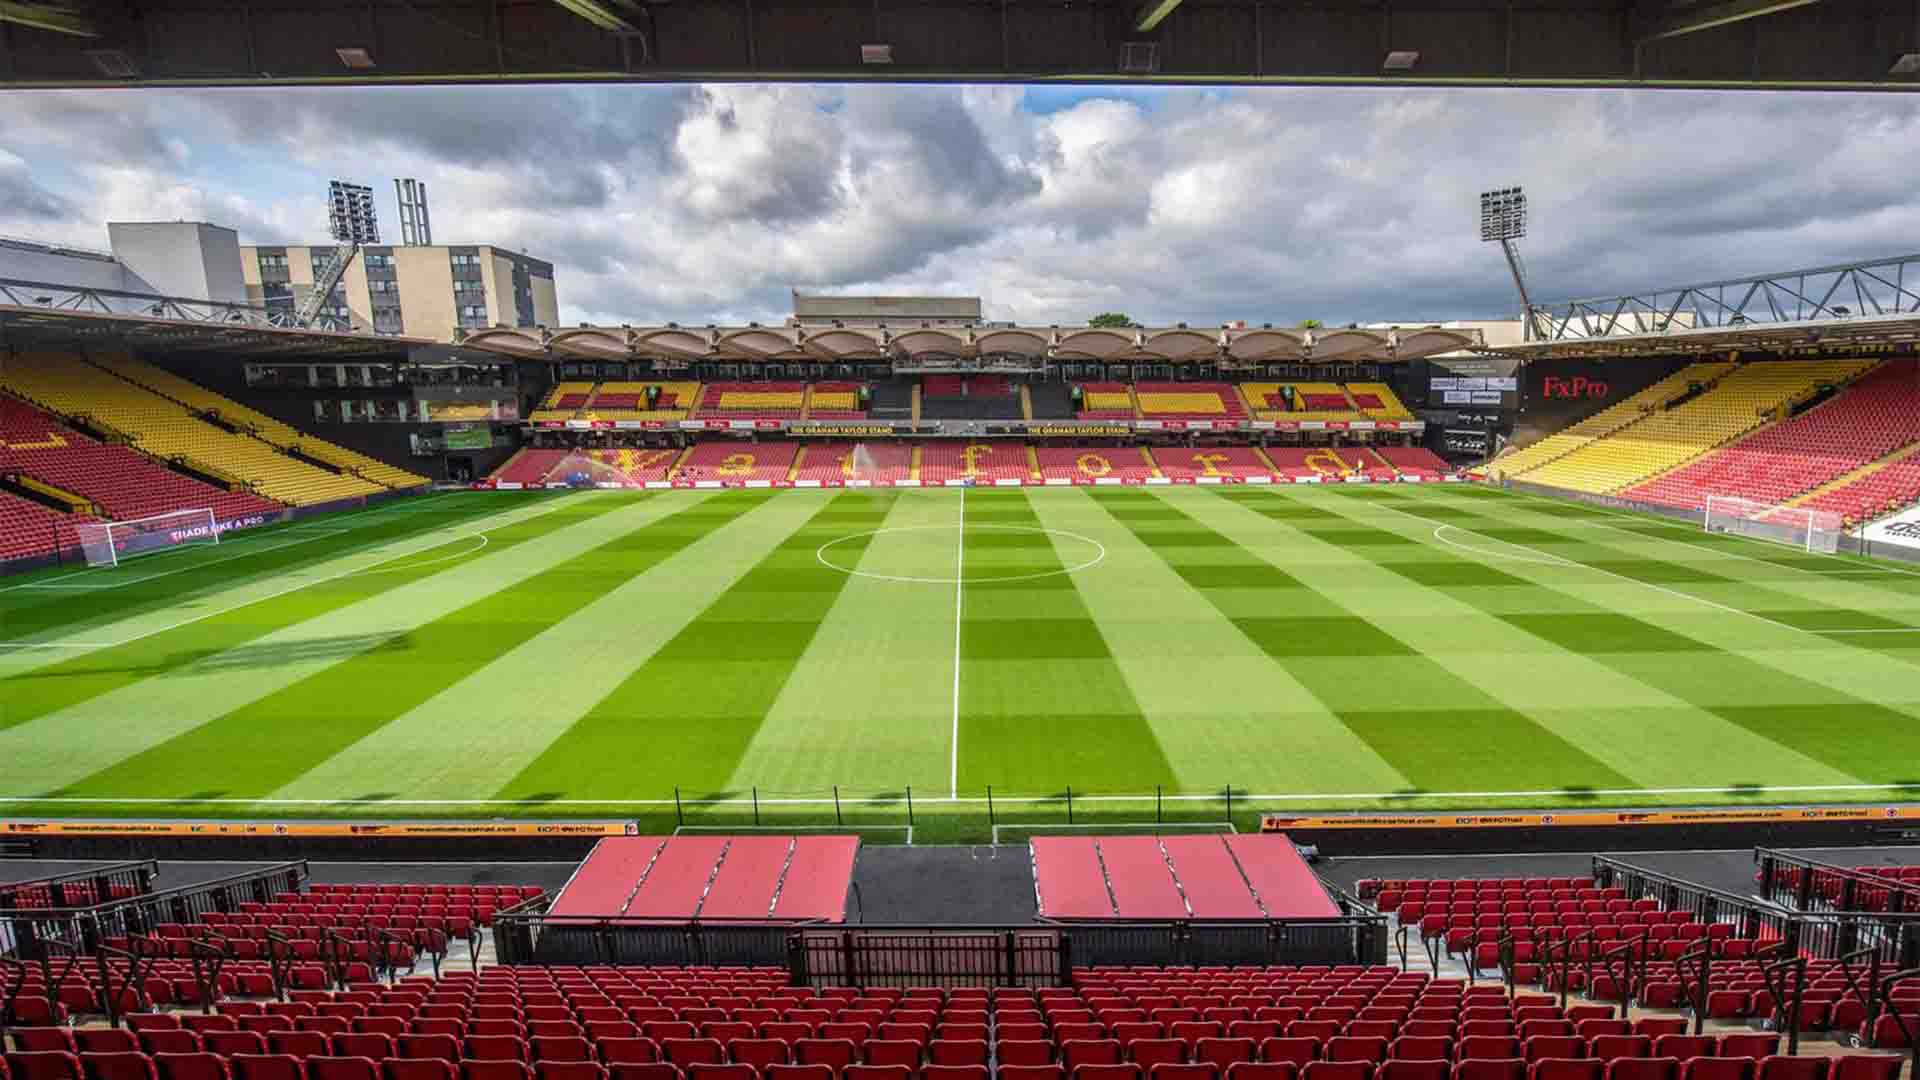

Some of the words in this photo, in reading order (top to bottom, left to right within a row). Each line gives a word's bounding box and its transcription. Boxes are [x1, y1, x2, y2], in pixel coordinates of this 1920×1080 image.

[1543, 377, 1607, 400] FxPro
[805, 426, 838, 434] GRAHAM
[839, 426, 866, 434] TAYLOR
[235, 519, 242, 528] A
